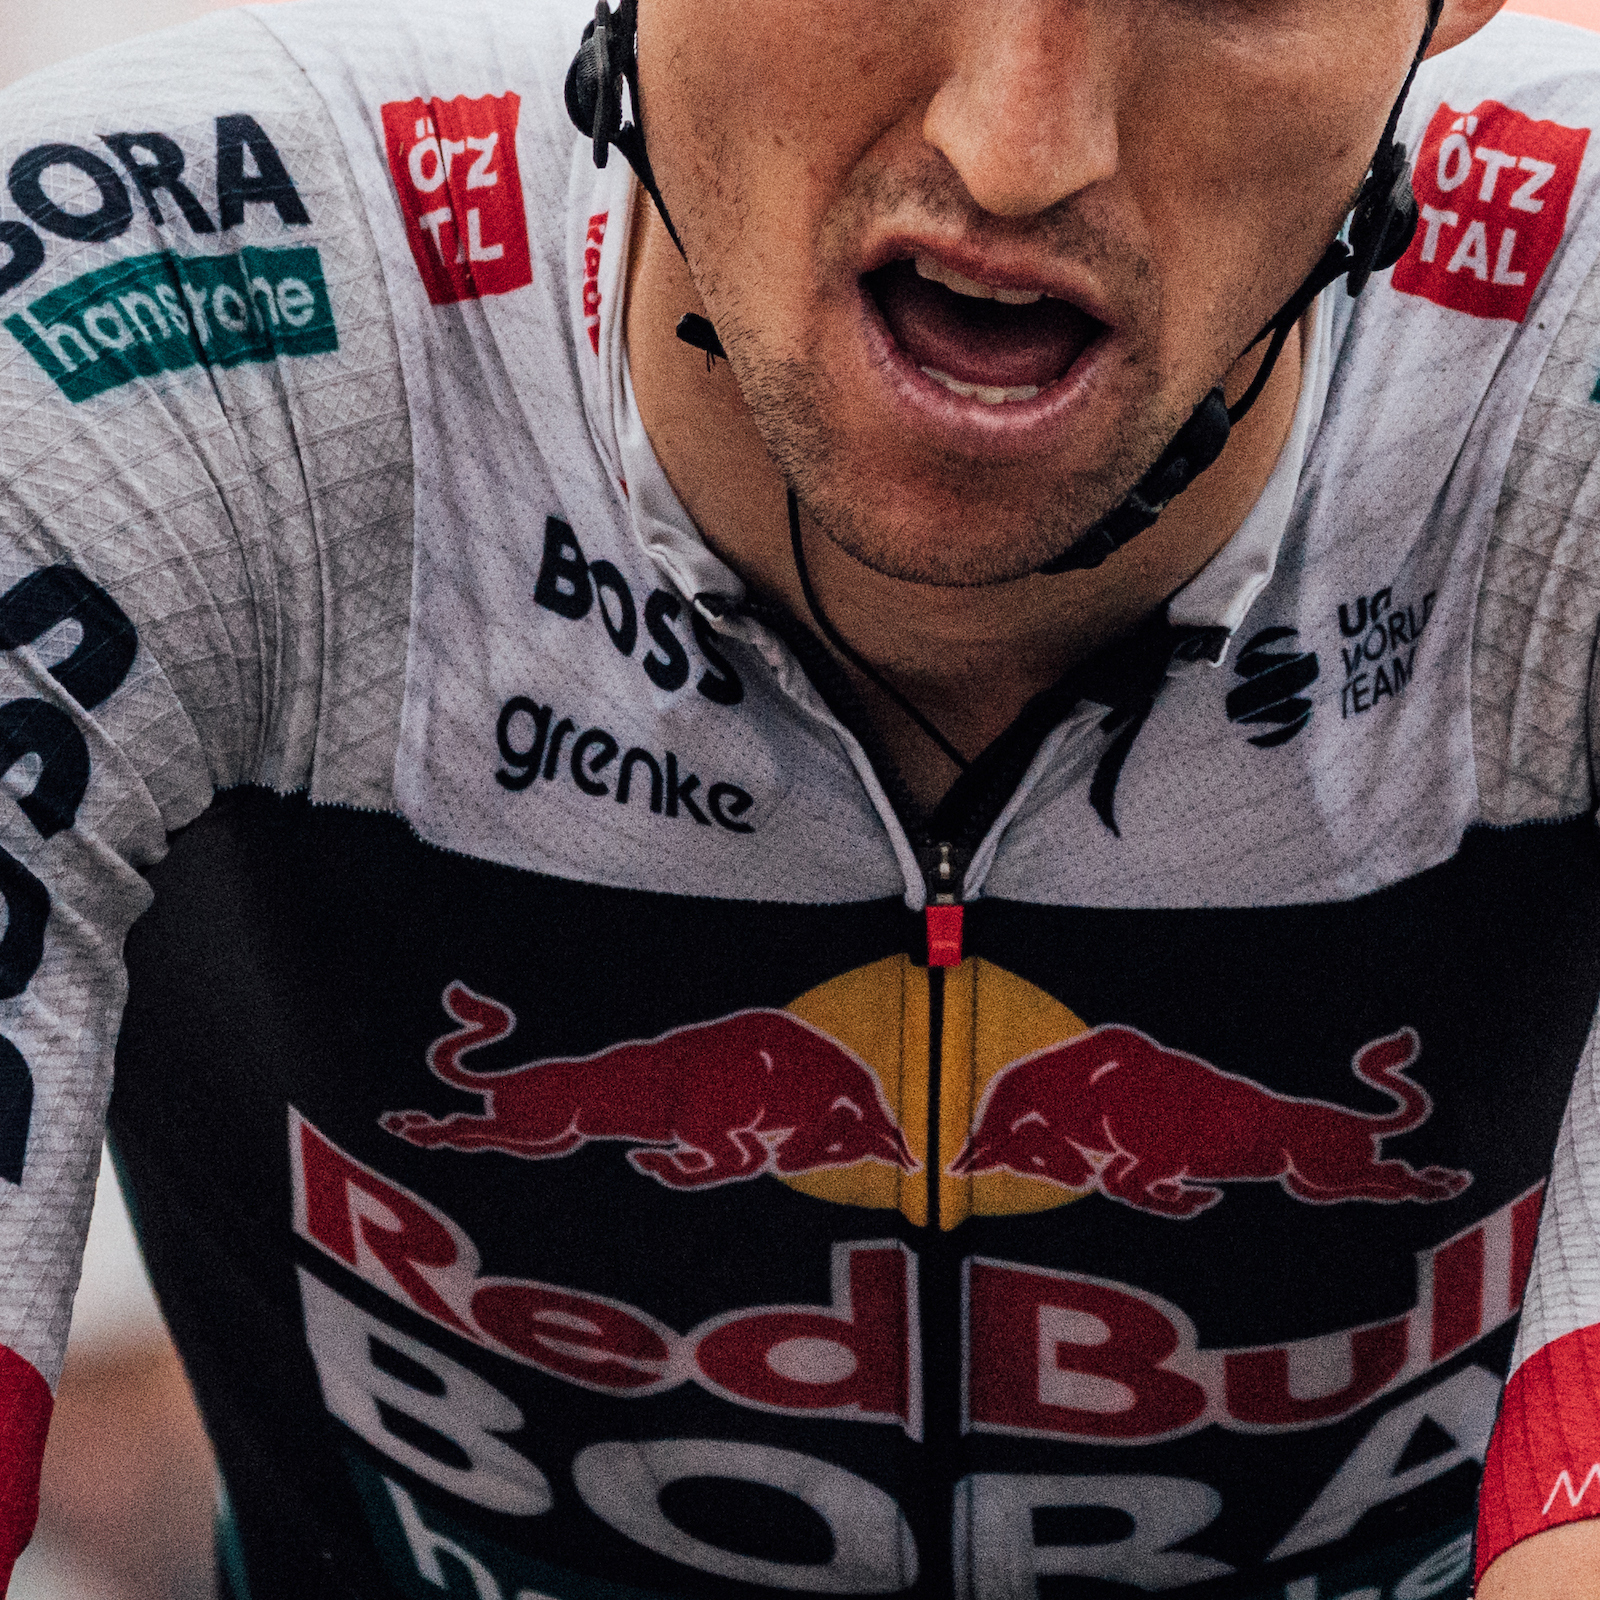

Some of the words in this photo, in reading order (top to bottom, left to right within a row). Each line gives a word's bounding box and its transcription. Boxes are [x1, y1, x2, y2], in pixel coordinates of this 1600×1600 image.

[1436, 115, 1557, 215] ÖTZ
[419, 206, 504, 267] TL
[1419, 202, 1529, 287] TAL
[533, 514, 745, 706] BOSS
[495, 695, 758, 834] grenke
[287, 1101, 925, 1444] Red
[295, 1264, 1506, 1600] BORA
